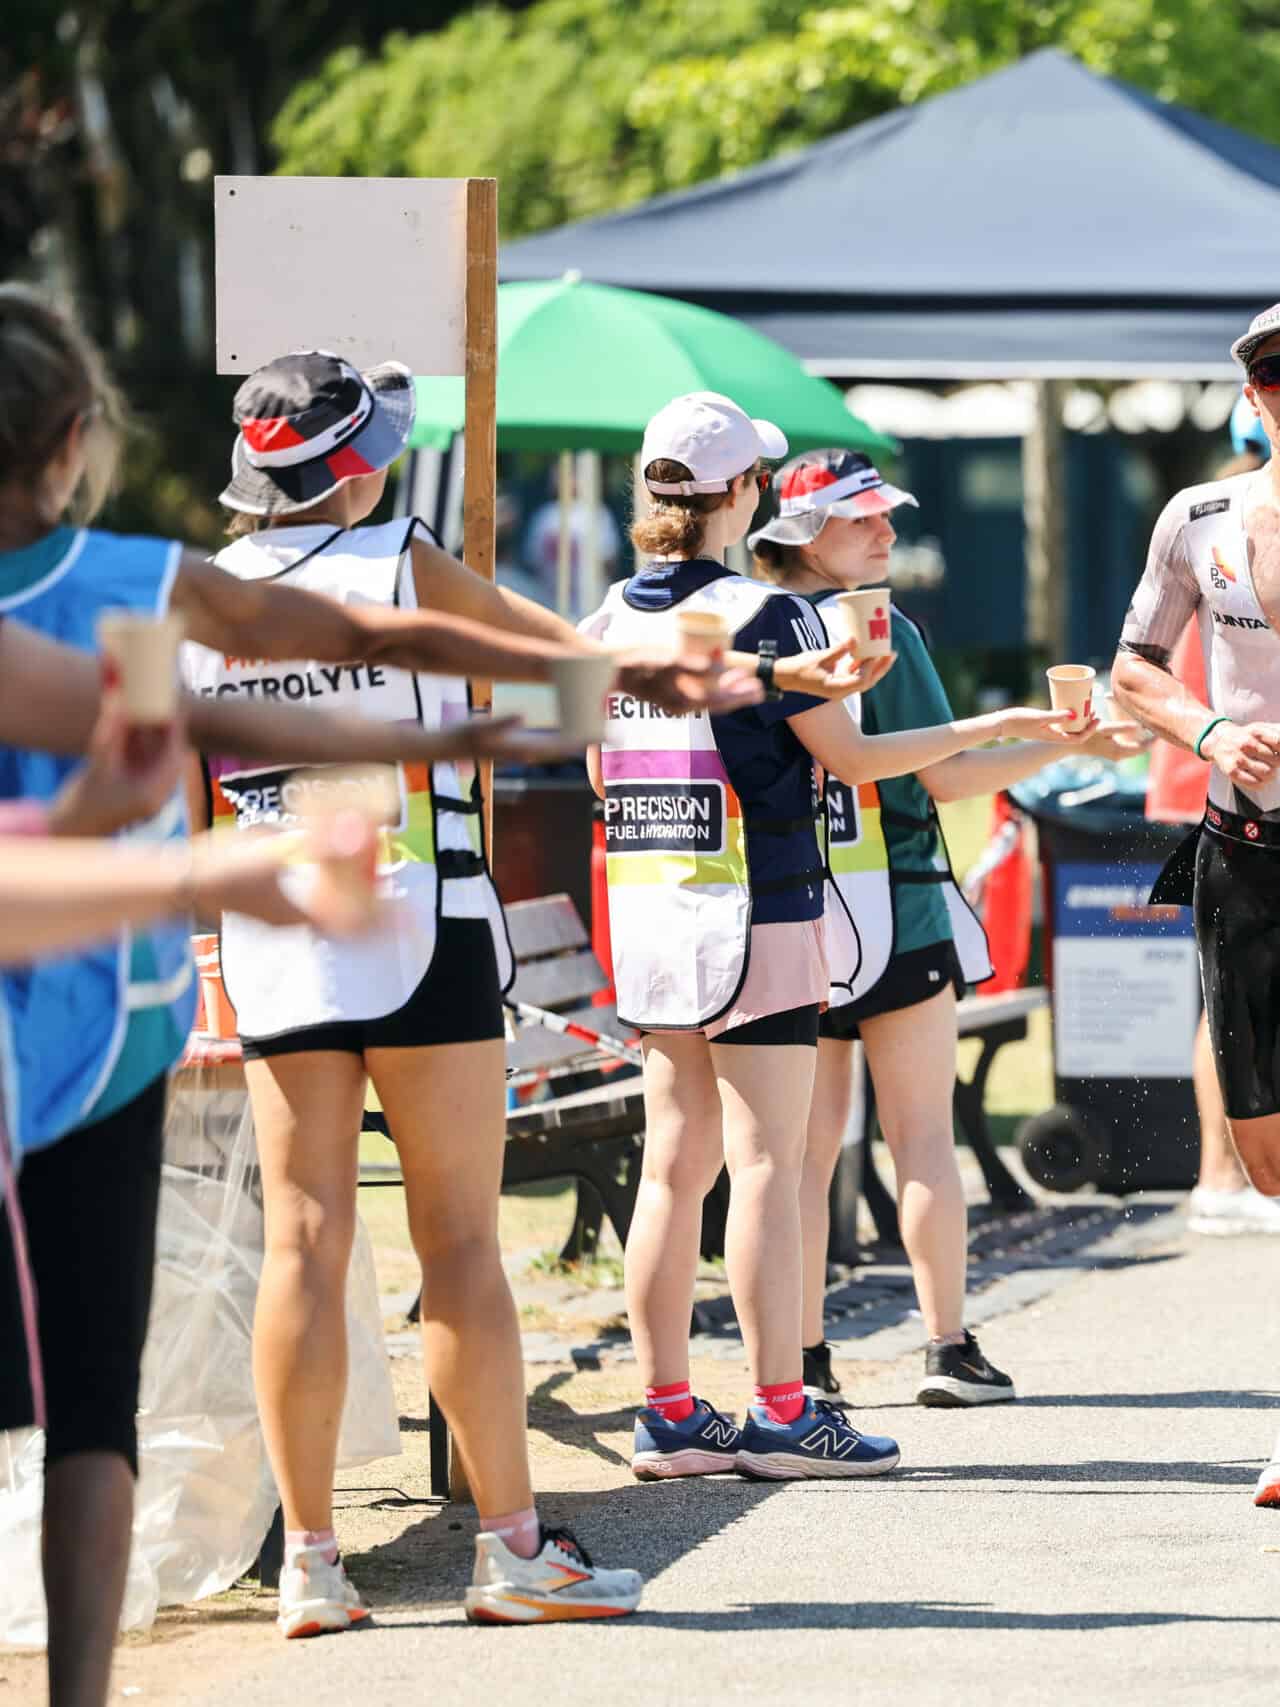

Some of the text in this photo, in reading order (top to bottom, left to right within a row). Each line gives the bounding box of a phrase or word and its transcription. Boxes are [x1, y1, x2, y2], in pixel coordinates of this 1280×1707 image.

[192, 663, 385, 701] ECTROLYTE
[603, 796, 711, 822] PRECISION
[605, 825, 639, 841] FUEL
[645, 825, 710, 840] HYDRATION
